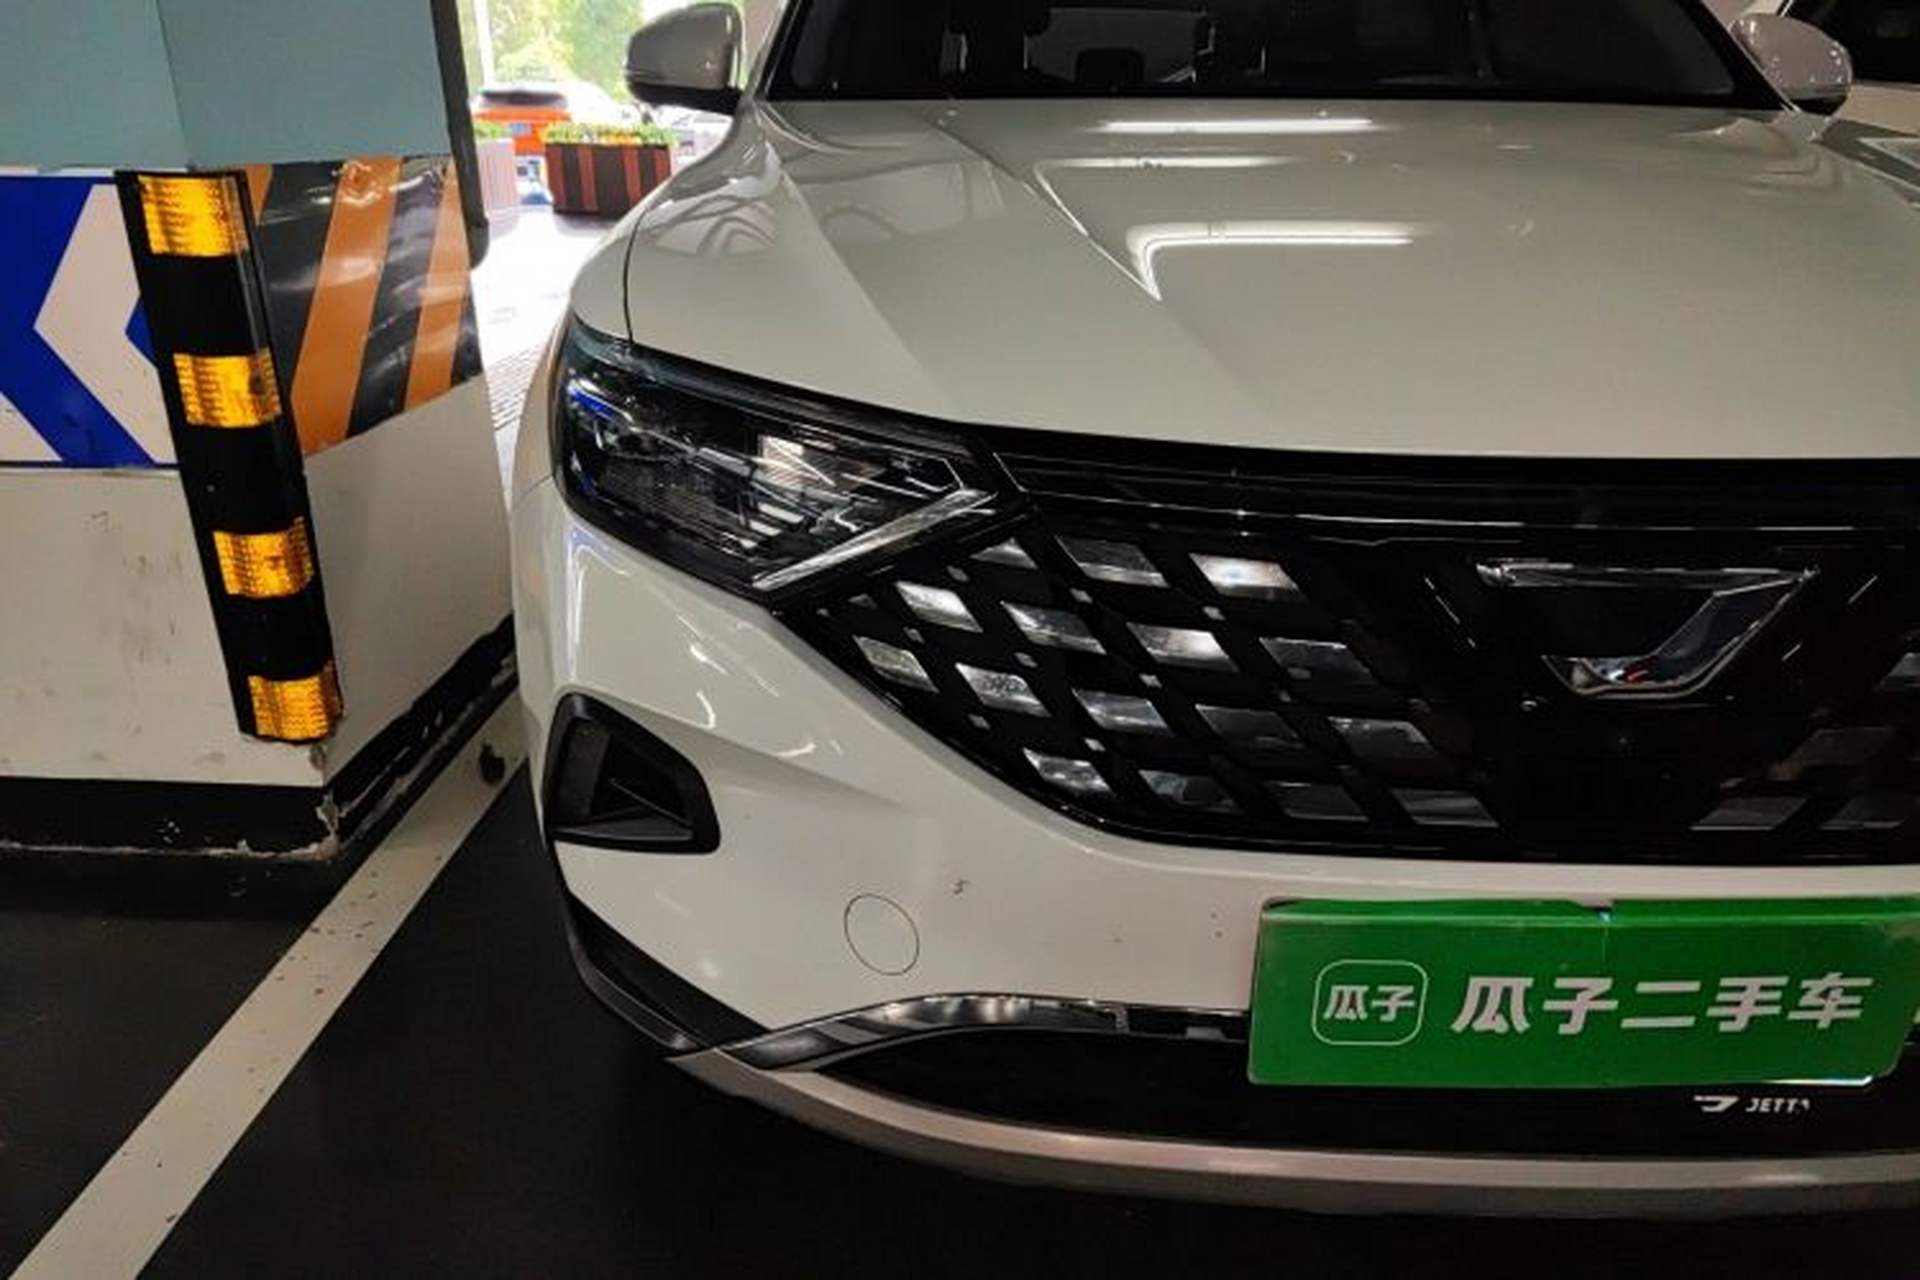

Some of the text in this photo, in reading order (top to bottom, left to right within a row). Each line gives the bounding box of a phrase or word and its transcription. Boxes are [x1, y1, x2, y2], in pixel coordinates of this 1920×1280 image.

[1324, 985, 1416, 1022] 瓜子
[1451, 972, 1874, 1035] 瓜子二手车
